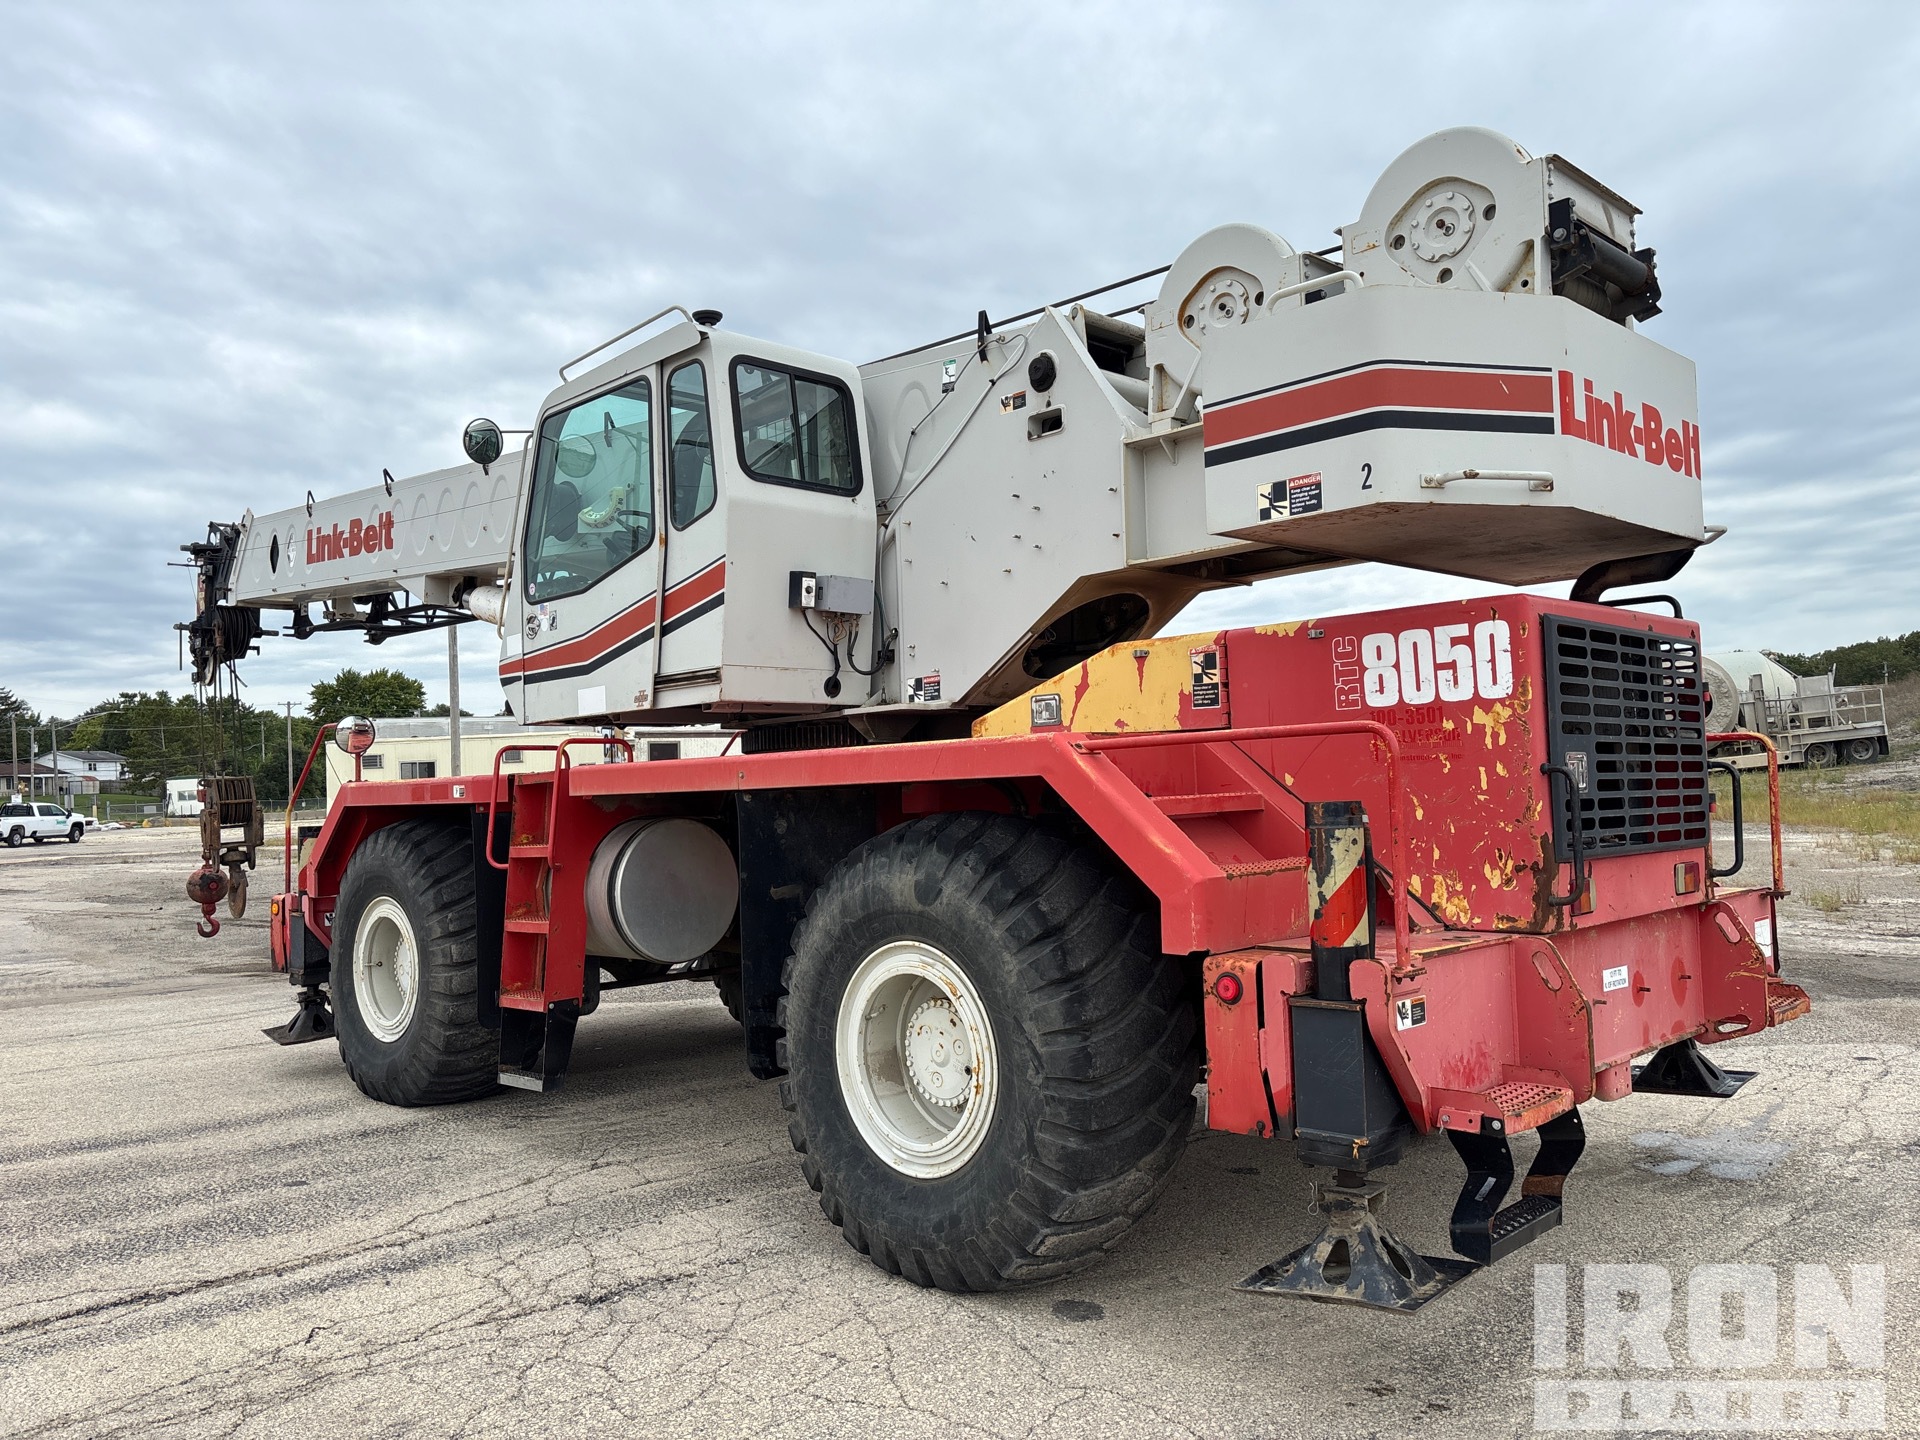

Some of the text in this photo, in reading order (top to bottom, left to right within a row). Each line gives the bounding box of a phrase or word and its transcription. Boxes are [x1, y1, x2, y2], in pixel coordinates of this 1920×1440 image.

[1558, 370, 1701, 480] Link-Belt
[1294, 475, 1321, 486] DANGER
[1361, 462, 1372, 490] 2
[306, 511, 394, 565] Link-Belt
[1332, 636, 1361, 710] RTC
[1361, 620, 1514, 707] 8050
